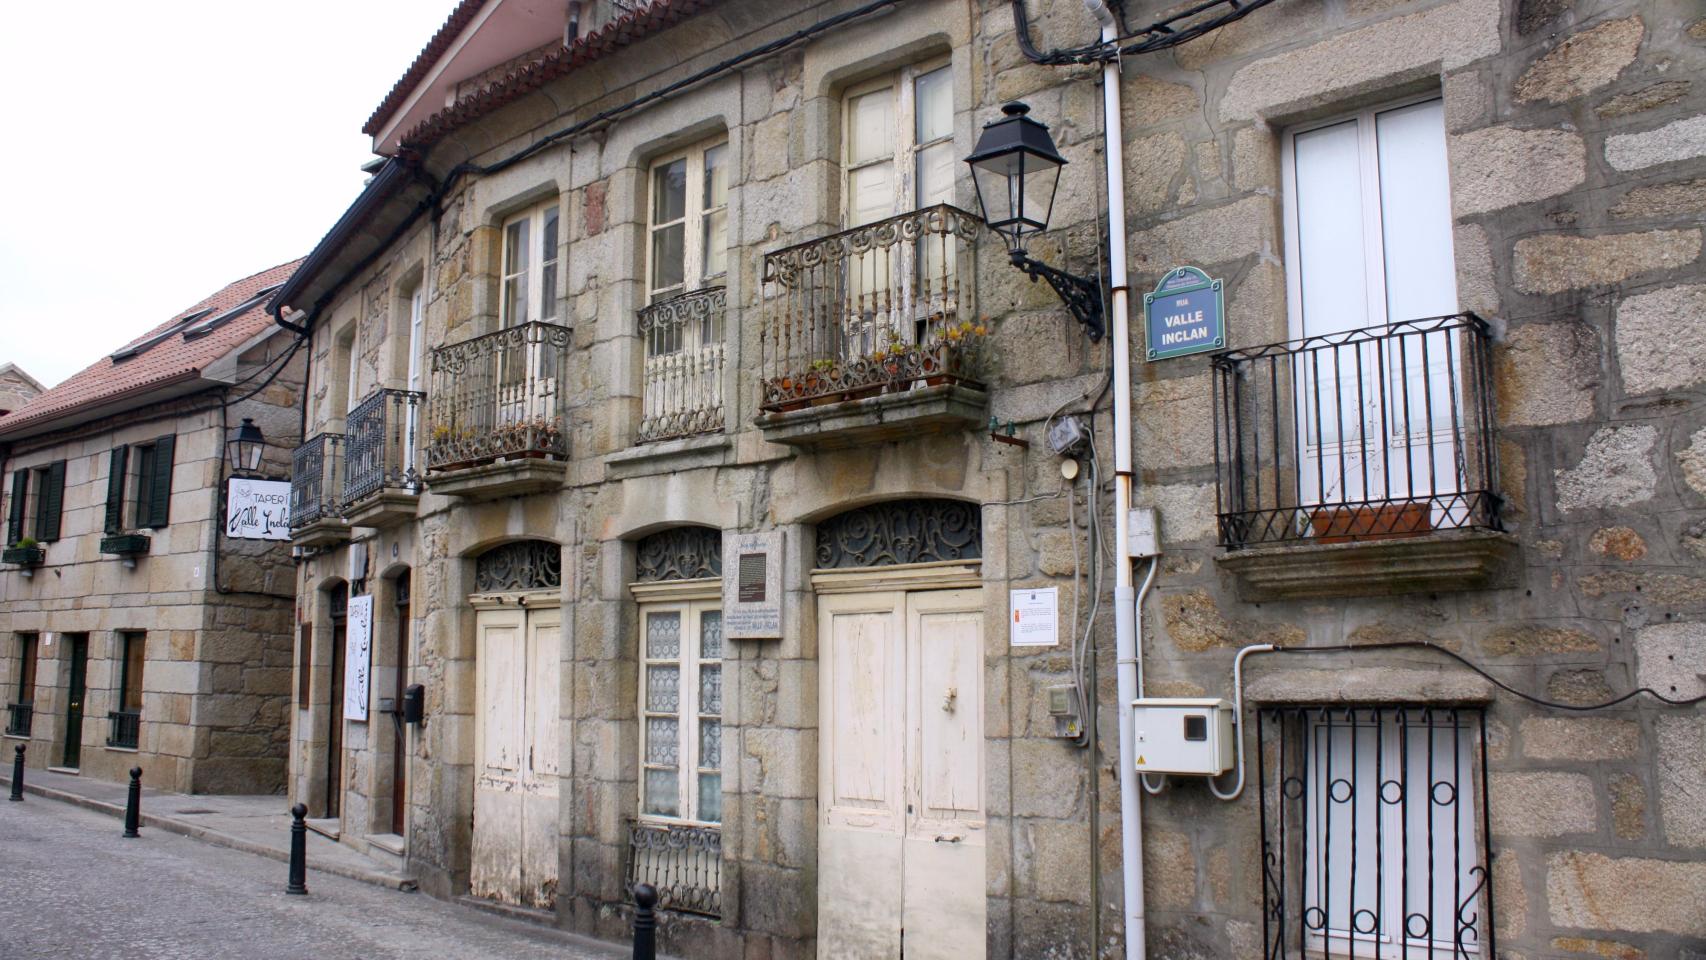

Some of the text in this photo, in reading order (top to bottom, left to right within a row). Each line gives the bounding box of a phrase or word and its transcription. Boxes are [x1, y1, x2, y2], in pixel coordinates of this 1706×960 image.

[1165, 311, 1203, 328] VALLE
[1162, 327, 1208, 345] INCLAN
[253, 493, 289, 505] TAPERÍ
[229, 506, 290, 535] Valle Inclá
